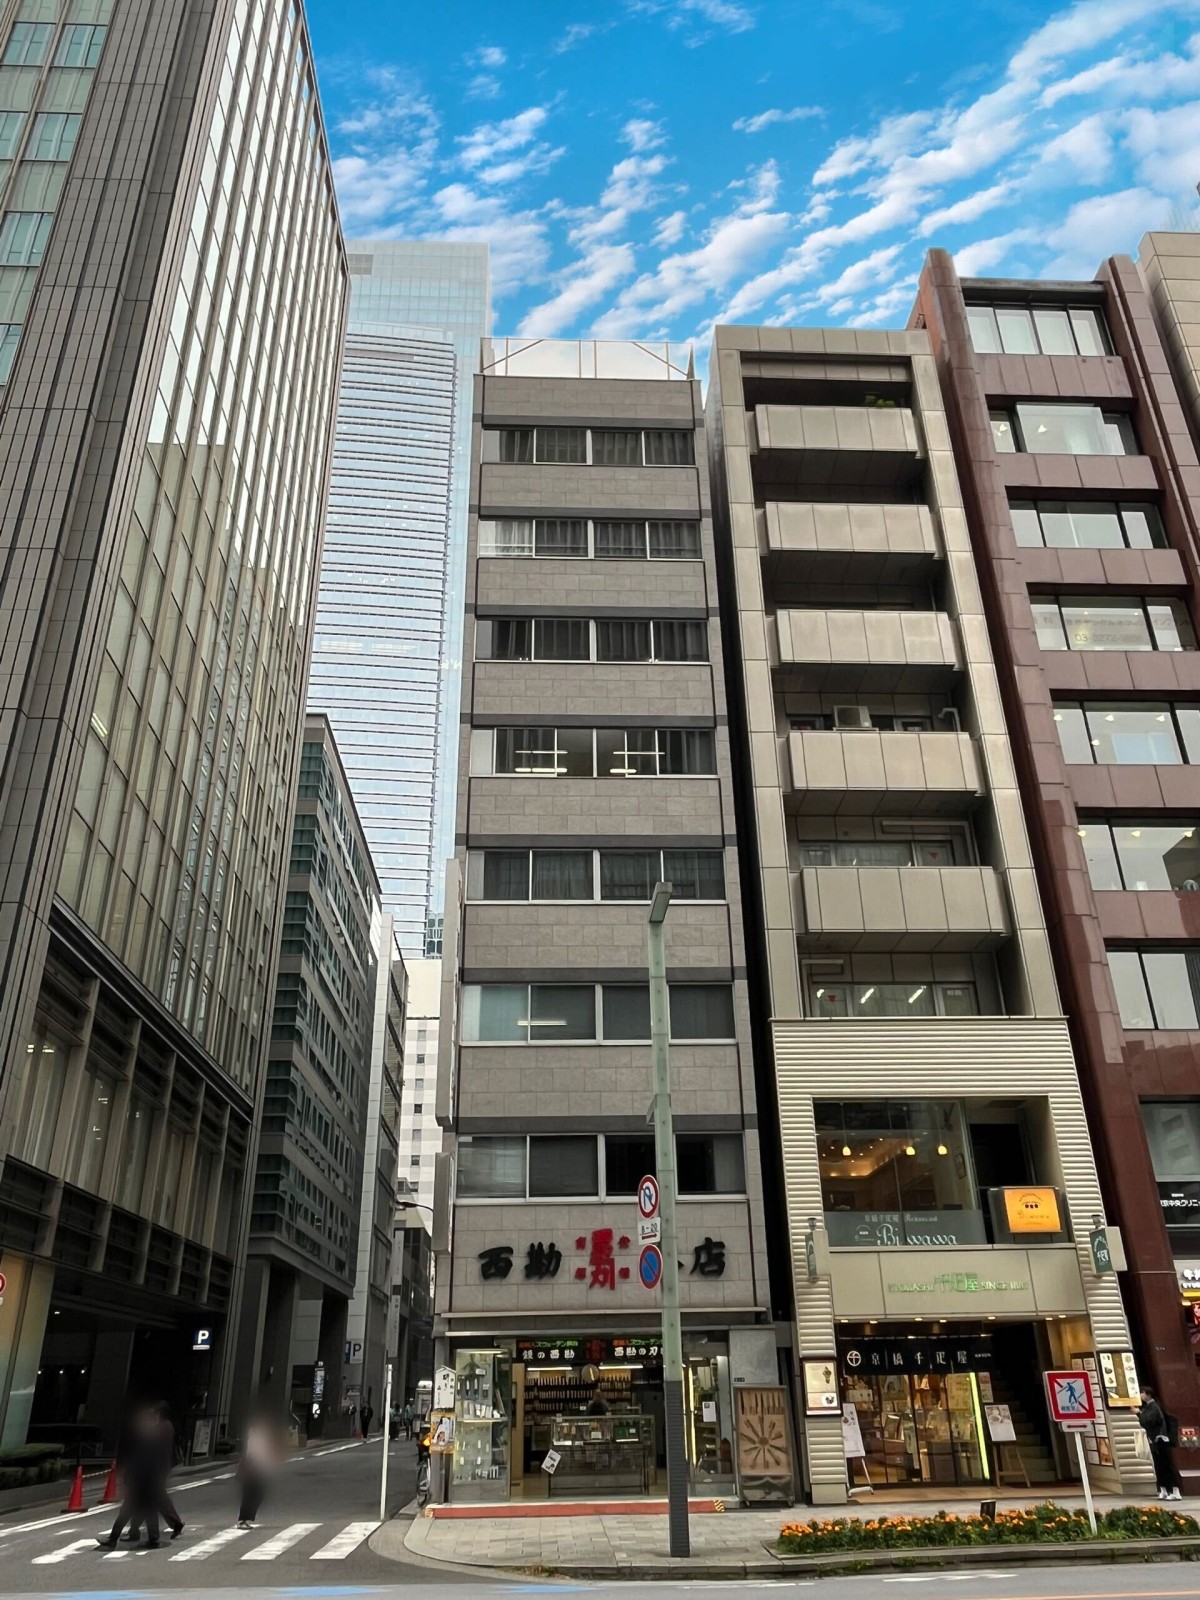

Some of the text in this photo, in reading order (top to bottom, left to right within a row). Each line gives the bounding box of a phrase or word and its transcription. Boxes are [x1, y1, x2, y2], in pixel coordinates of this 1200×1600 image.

[478, 1242, 562, 1280] 西勘
[197, 1330, 209, 1344] P
[353, 1344, 362, 1357] P
